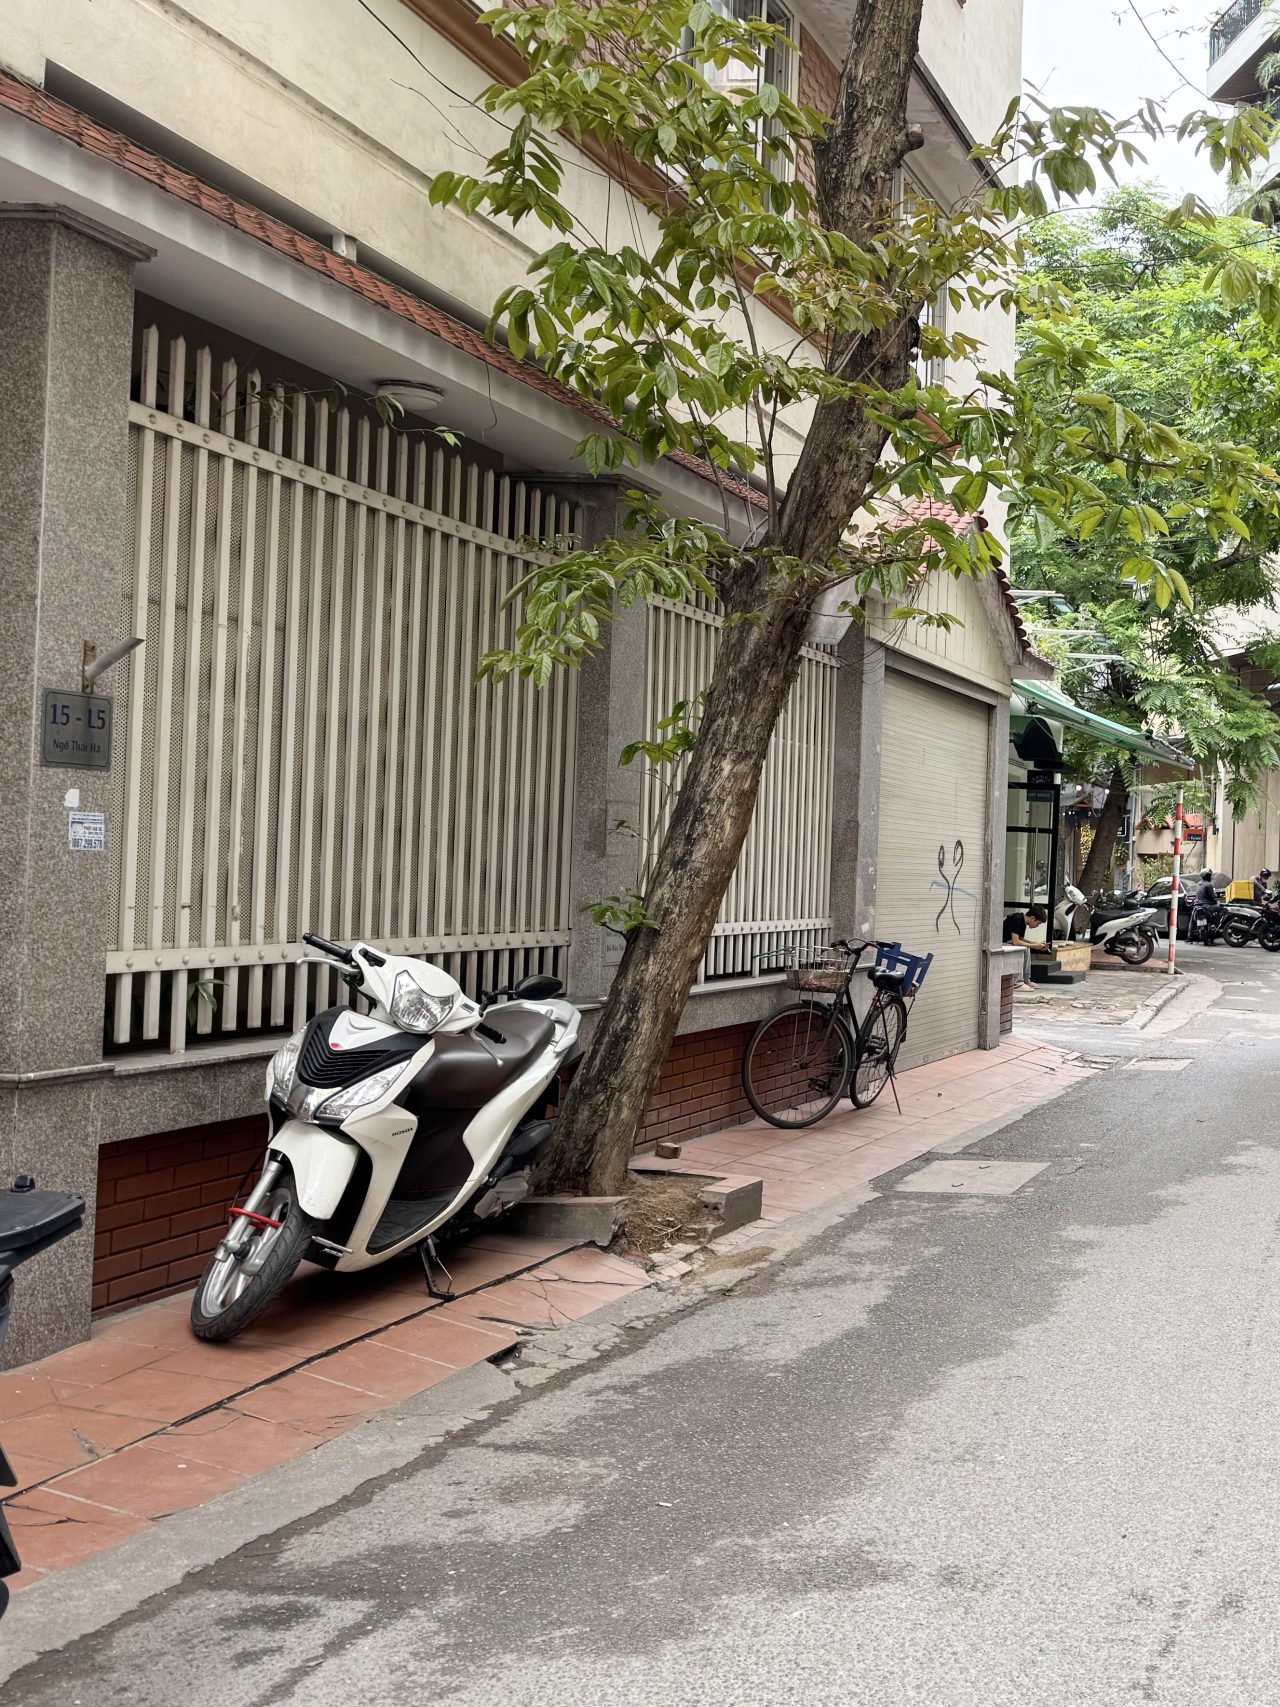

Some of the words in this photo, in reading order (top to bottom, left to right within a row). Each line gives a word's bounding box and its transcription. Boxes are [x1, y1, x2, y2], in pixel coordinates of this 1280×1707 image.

[49, 703, 71, 726] 15
[87, 707, 107, 730] L5
[391, 1127, 413, 1137] HONDA
